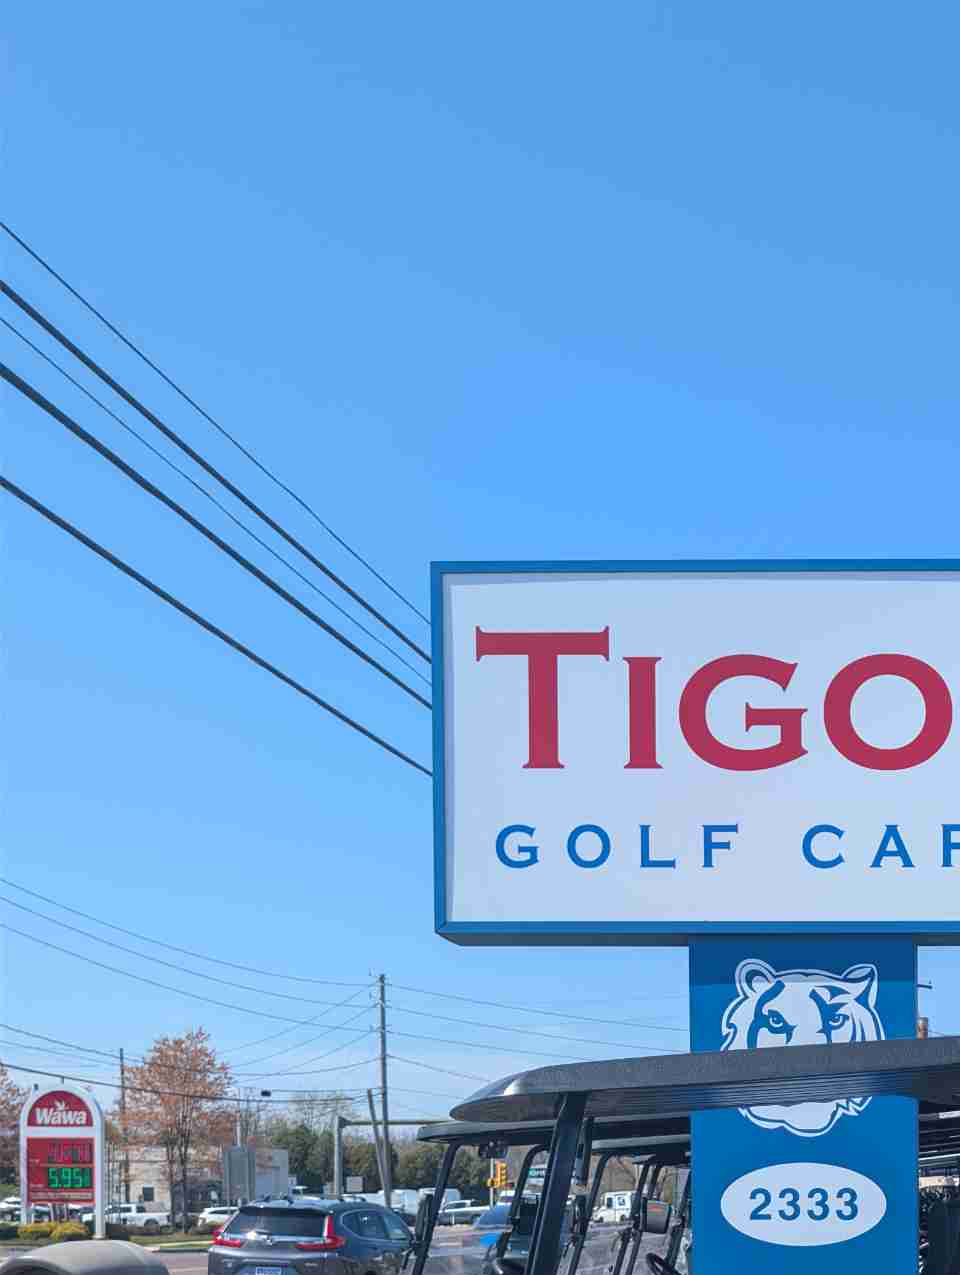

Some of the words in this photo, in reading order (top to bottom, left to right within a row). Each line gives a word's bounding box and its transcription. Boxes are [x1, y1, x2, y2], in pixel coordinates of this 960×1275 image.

[495, 823, 739, 869] GOLF
[35, 1107, 87, 1125] Wawa
[749, 1187, 859, 1221] 2333
